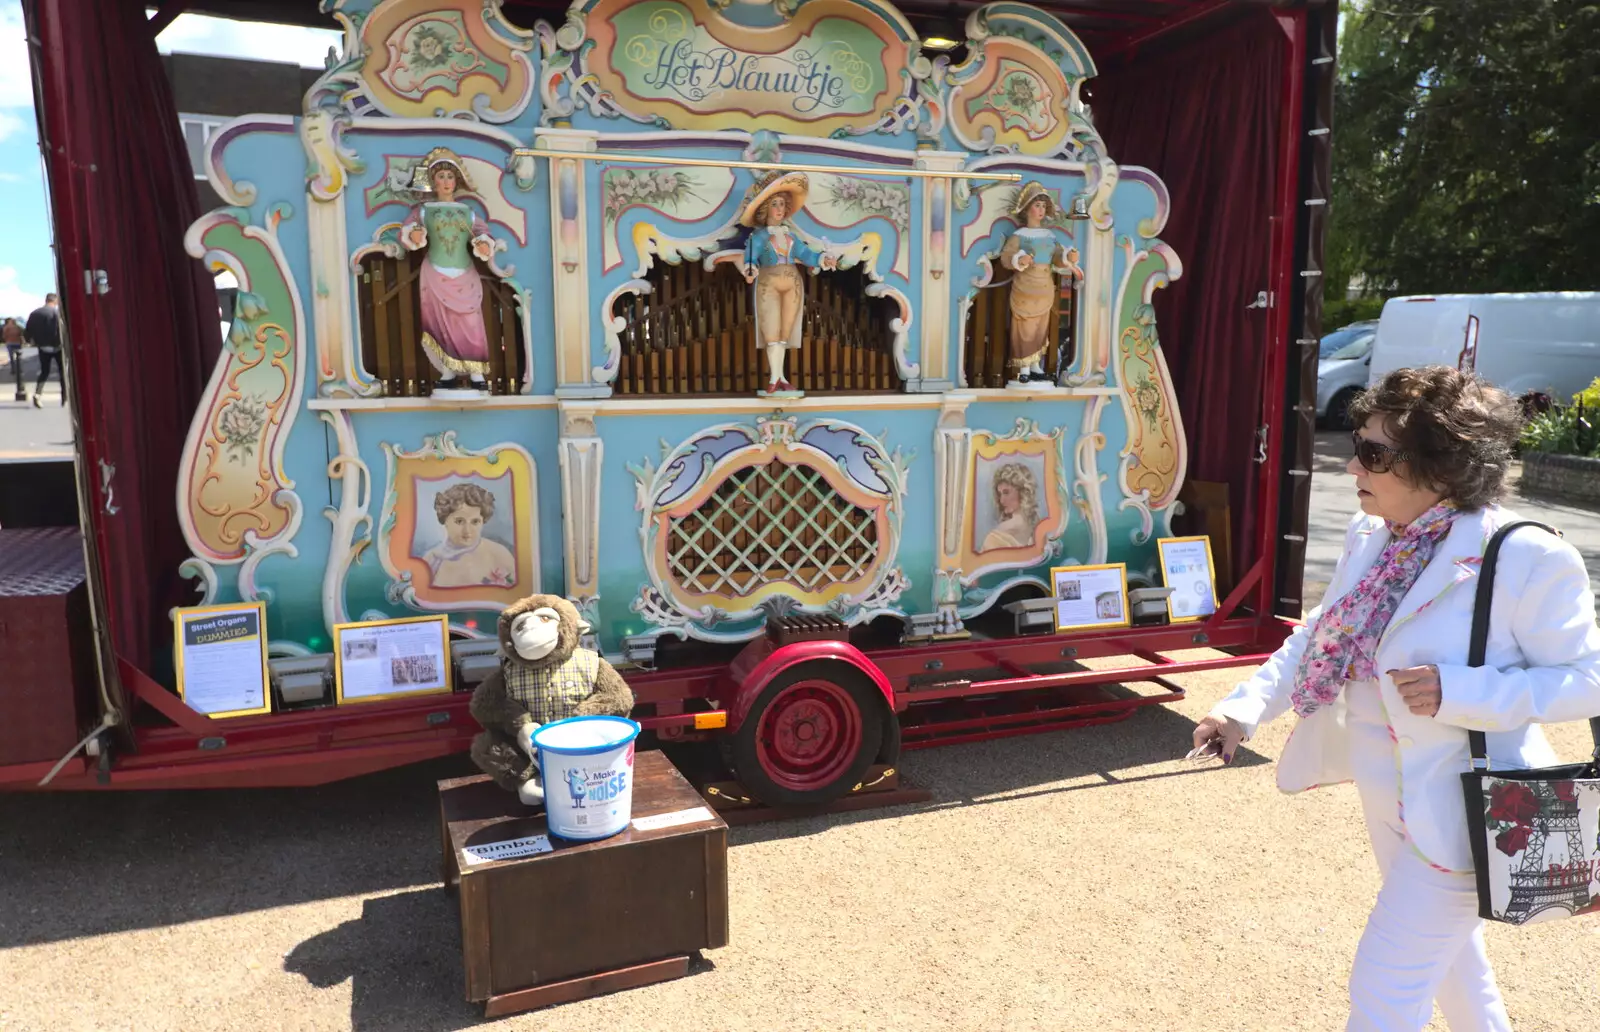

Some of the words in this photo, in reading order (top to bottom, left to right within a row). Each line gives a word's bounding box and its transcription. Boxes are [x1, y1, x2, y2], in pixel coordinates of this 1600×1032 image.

[644, 39, 704, 101] Het
[708, 46, 845, 112] Blauwtje
[191, 621, 217, 632] Street
[217, 616, 247, 627] Organs
[196, 628, 248, 643] DUMMIES
[593, 769, 616, 780] Make
[588, 772, 626, 801] NOISE
[498, 847, 543, 858] monkey
